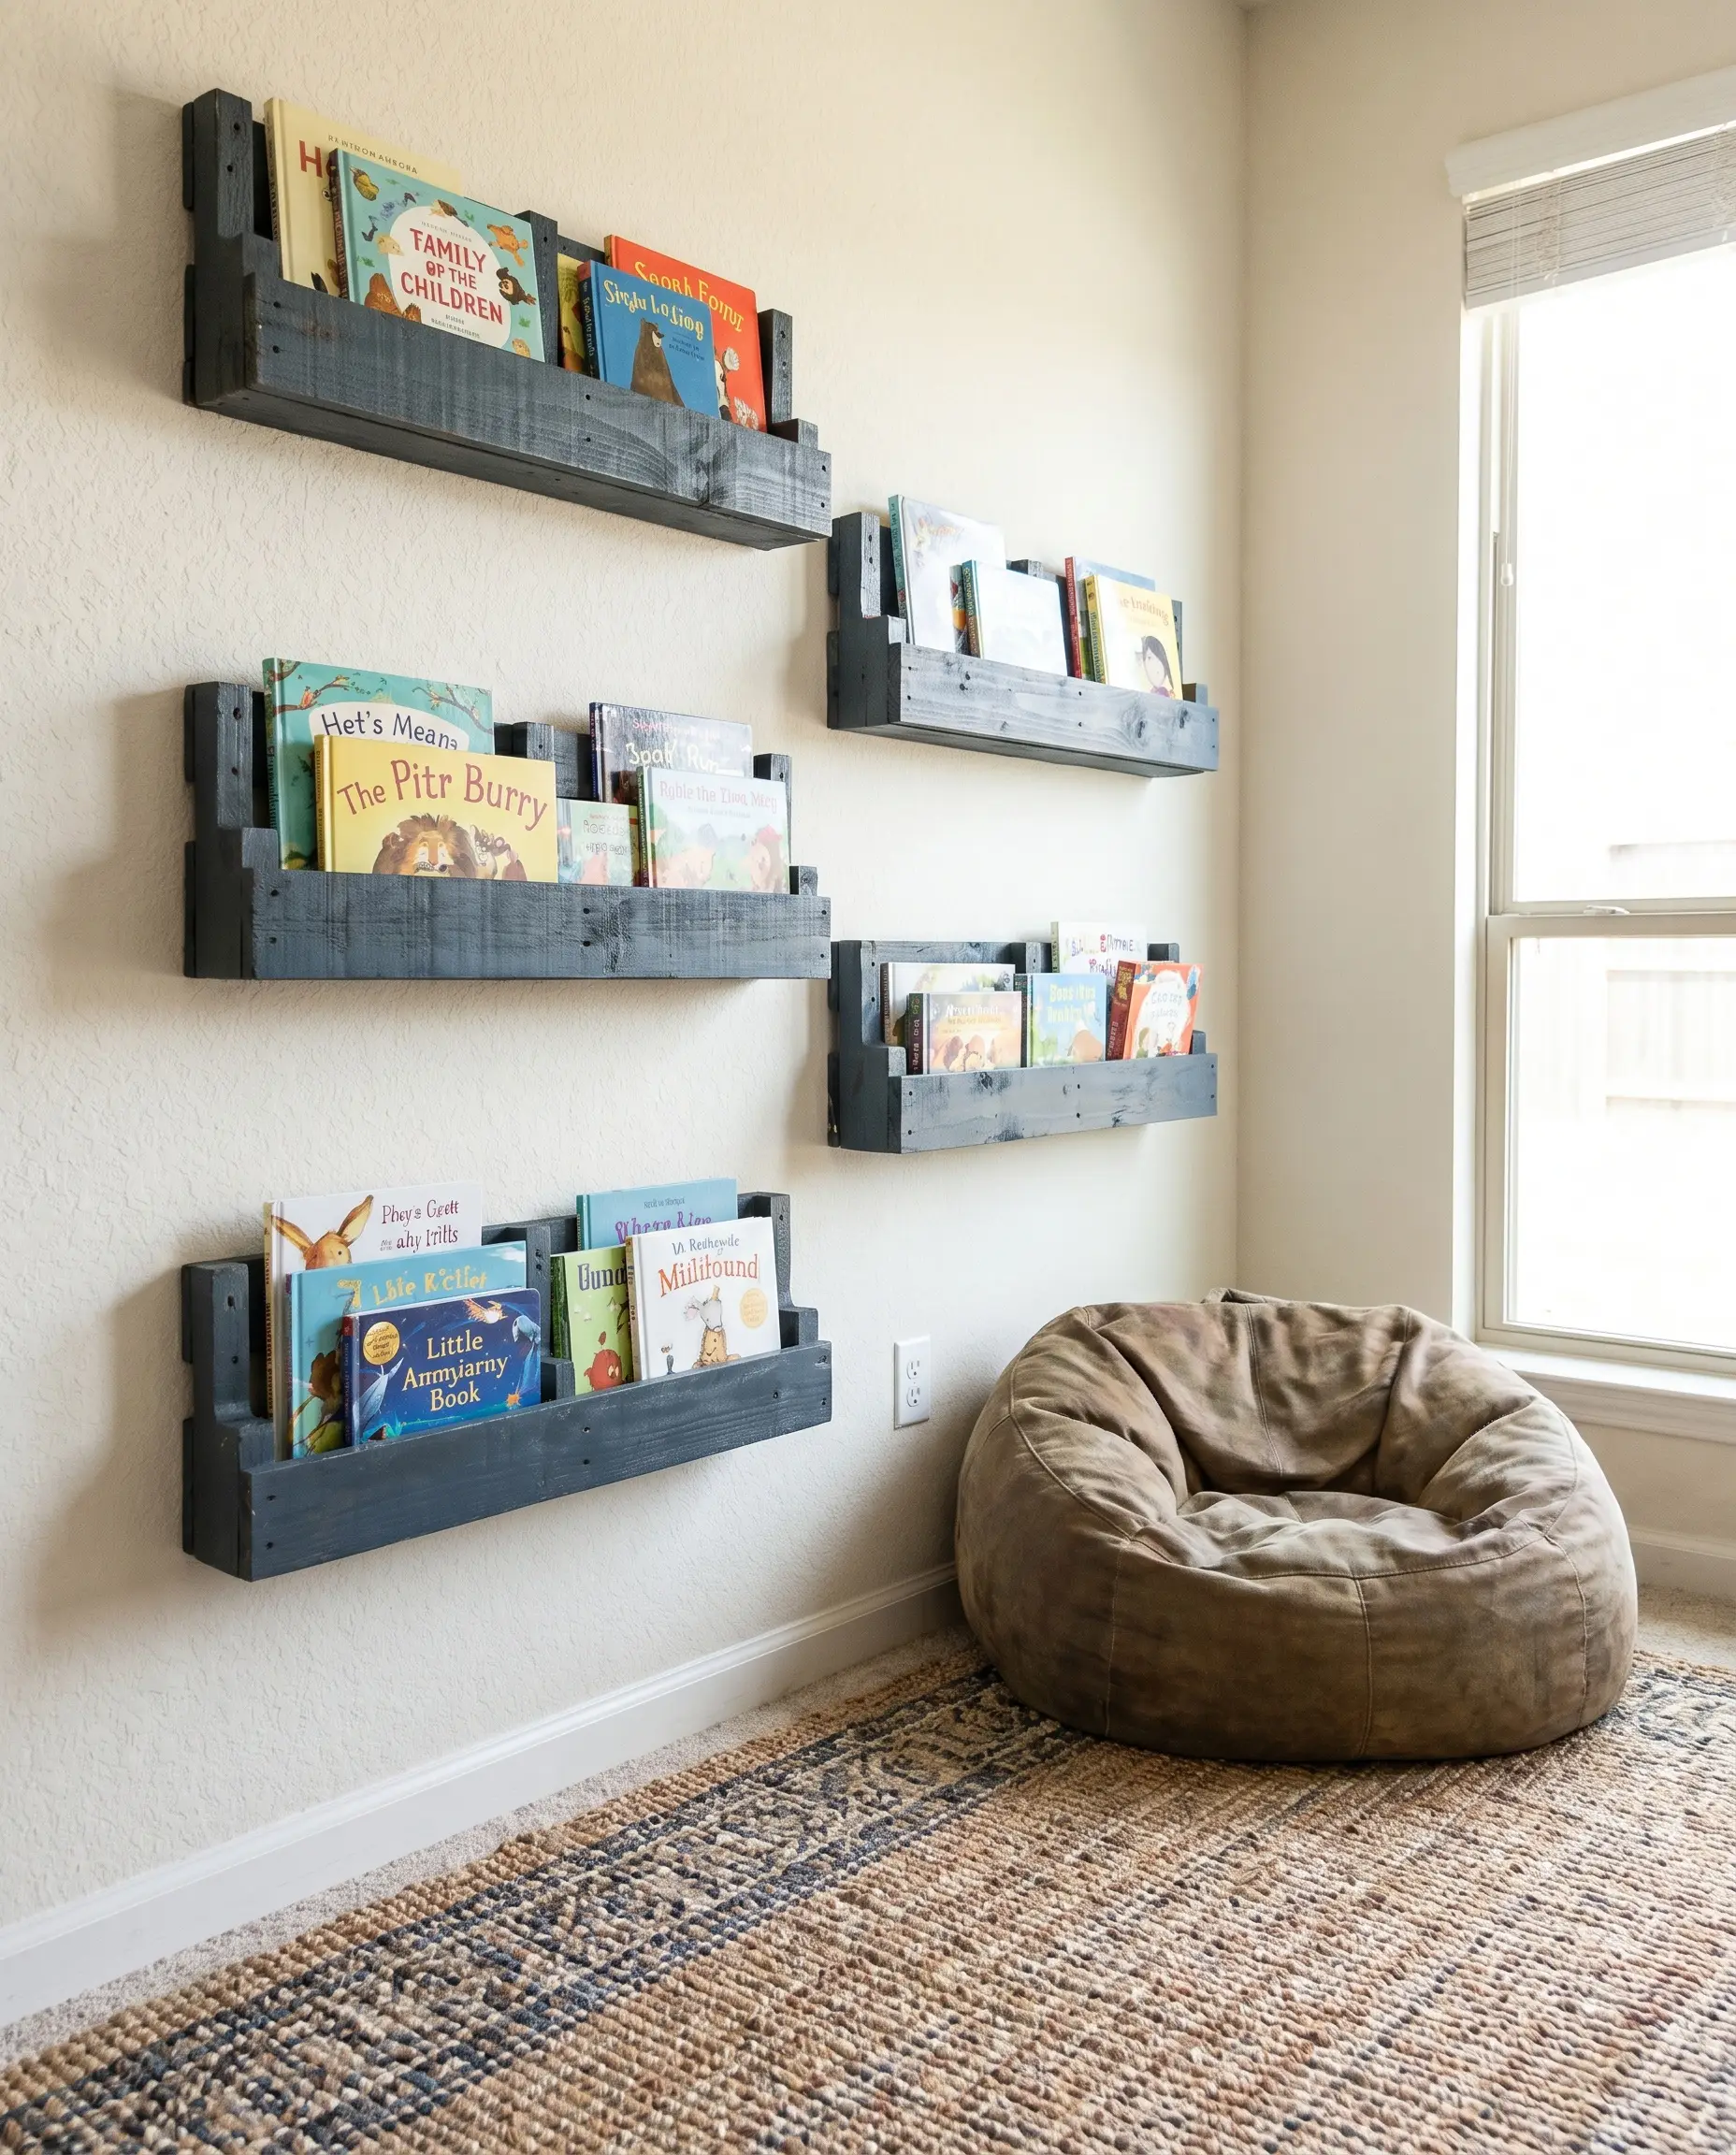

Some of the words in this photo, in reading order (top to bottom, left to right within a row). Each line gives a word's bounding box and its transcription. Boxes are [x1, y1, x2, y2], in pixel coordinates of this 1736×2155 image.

[410, 227, 486, 273] FAMILY
[448, 268, 477, 290] THE
[400, 271, 503, 325] CHILDREN
[321, 710, 383, 736] Het's
[337, 781, 386, 815] The
[391, 759, 453, 801] Pitr
[464, 763, 548, 832] Burry
[427, 1329, 484, 1359] Little
[430, 1381, 481, 1411] Book
